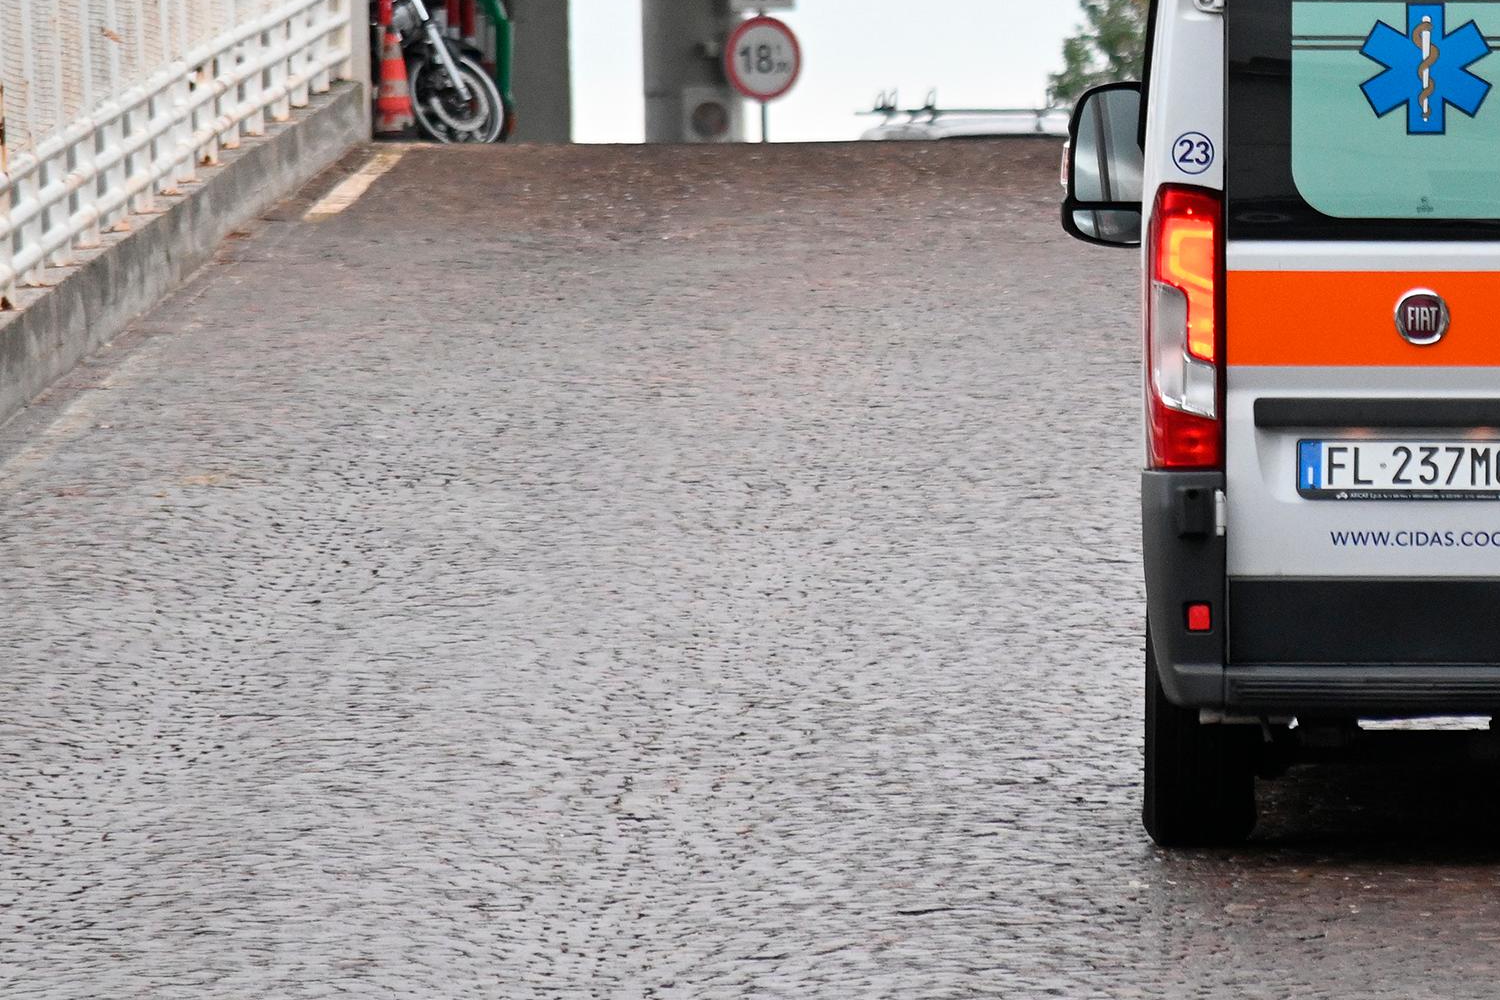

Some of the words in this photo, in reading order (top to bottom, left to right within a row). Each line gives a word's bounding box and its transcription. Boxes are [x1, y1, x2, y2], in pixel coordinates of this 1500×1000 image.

[1179, 139, 1210, 165] 23
[1407, 306, 1438, 331] FIAT
[1327, 446, 1374, 485] FL
